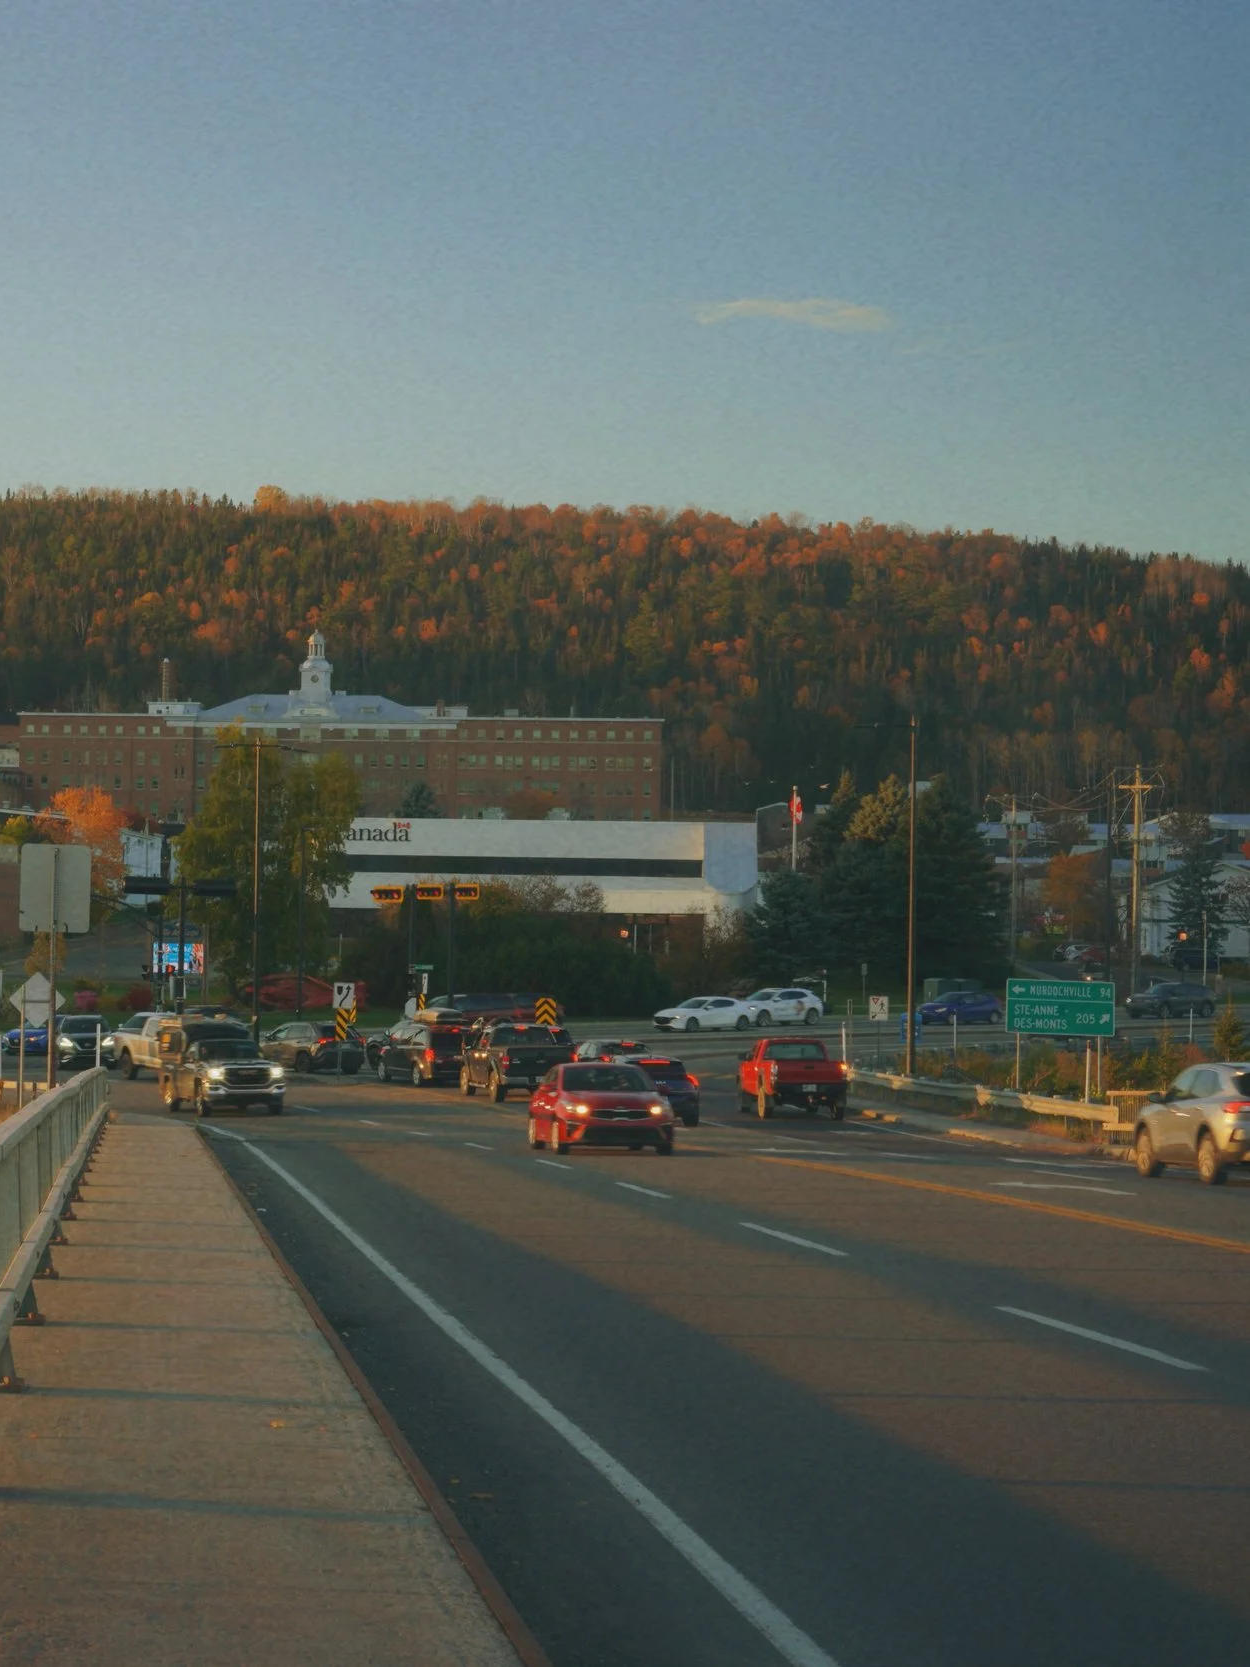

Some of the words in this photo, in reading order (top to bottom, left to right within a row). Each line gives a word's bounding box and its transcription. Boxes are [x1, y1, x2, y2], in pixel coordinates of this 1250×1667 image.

[346, 822, 411, 842] anada
[1030, 985, 1092, 998] MURDOCHVILLE
[1100, 987, 1111, 998] 94
[1014, 1004, 1059, 1016] STE-ANNE
[1014, 1018, 1068, 1030] DES-MONTS
[1076, 1013, 1095, 1024] 205
